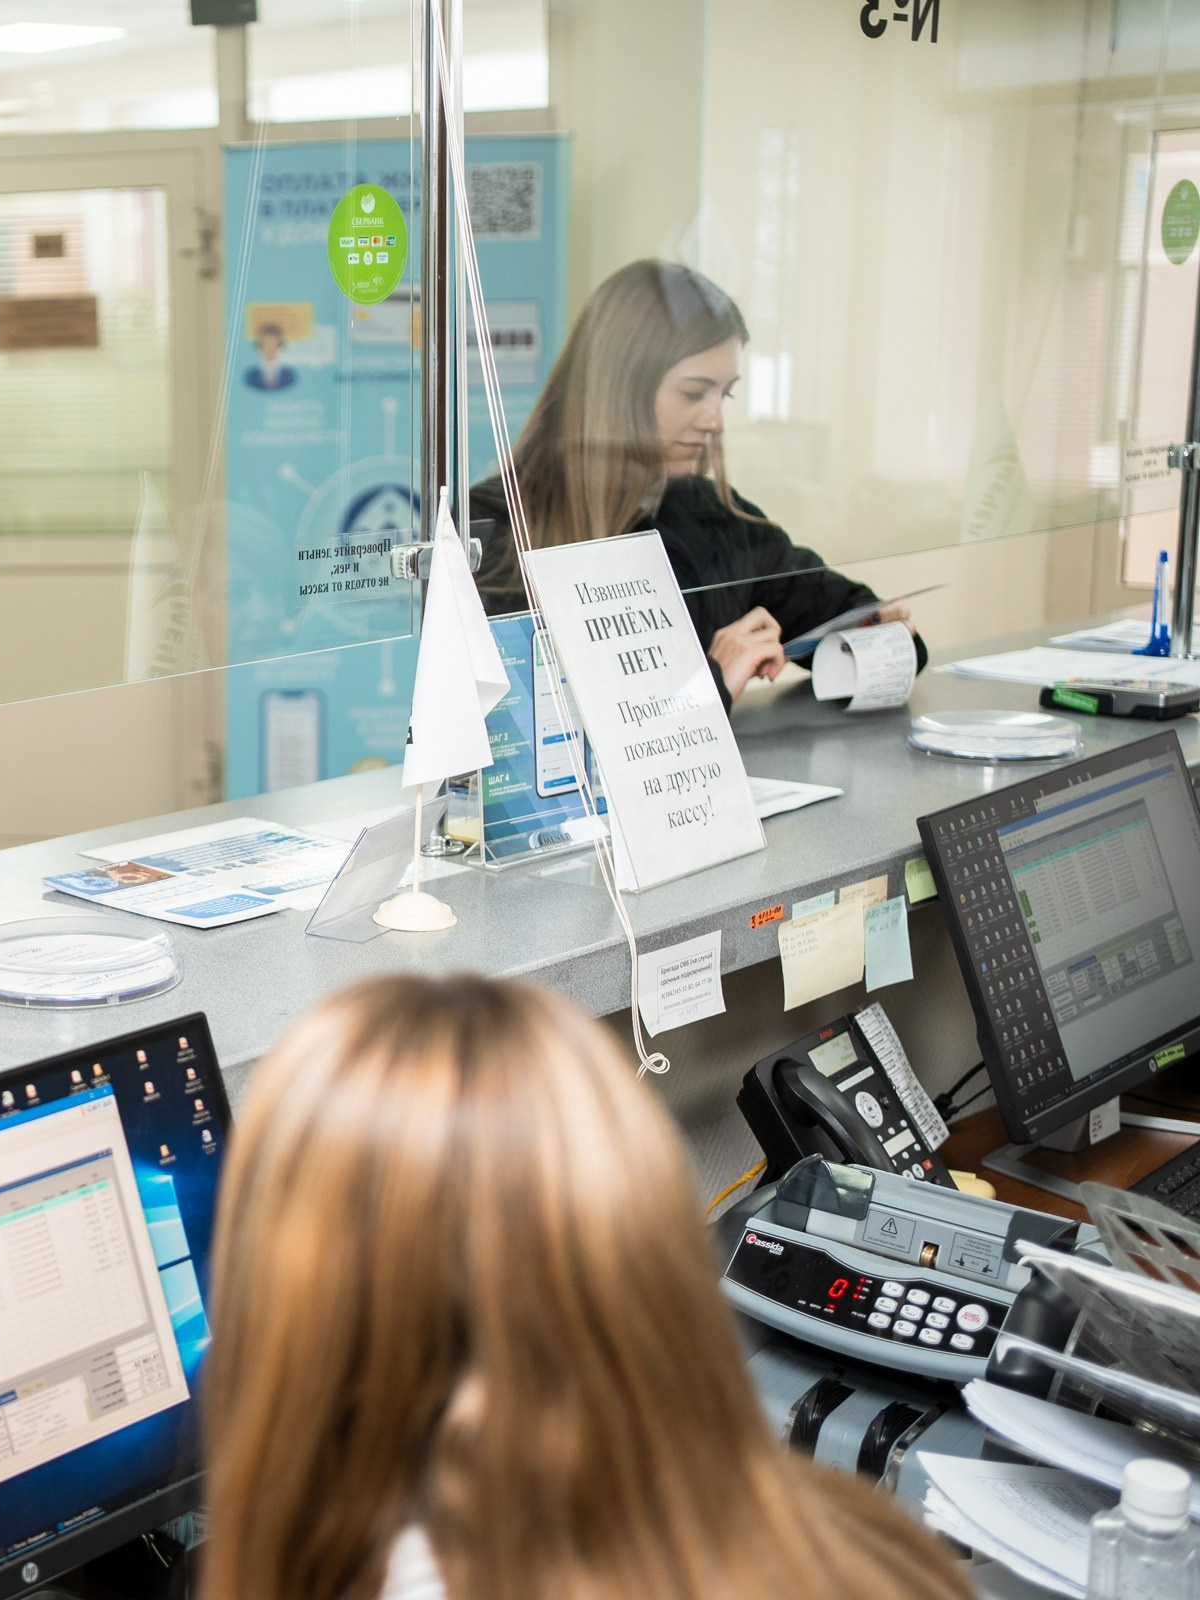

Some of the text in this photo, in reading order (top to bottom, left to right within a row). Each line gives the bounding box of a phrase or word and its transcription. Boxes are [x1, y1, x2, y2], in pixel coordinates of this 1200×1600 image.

[351, 217, 384, 226] СБЕРБАНК
[573, 578, 657, 605] Извините,
[584, 606, 674, 642] ПРИЁМА
[616, 645, 667, 676] НЕТ!
[616, 693, 700, 728] Пройдите,
[623, 725, 719, 762] пожалуйста,
[488, 772, 510, 785] ШАГ 4
[643, 762, 721, 796] на другую
[667, 794, 715, 829] кассу!
[543, 832, 571, 846] МЕЧЕЛ
[660, 964, 679, 976] Бригада
[660, 975, 680, 987] срочных
[745, 1233, 785, 1253] Cassida
[828, 1278, 849, 1299] 0
